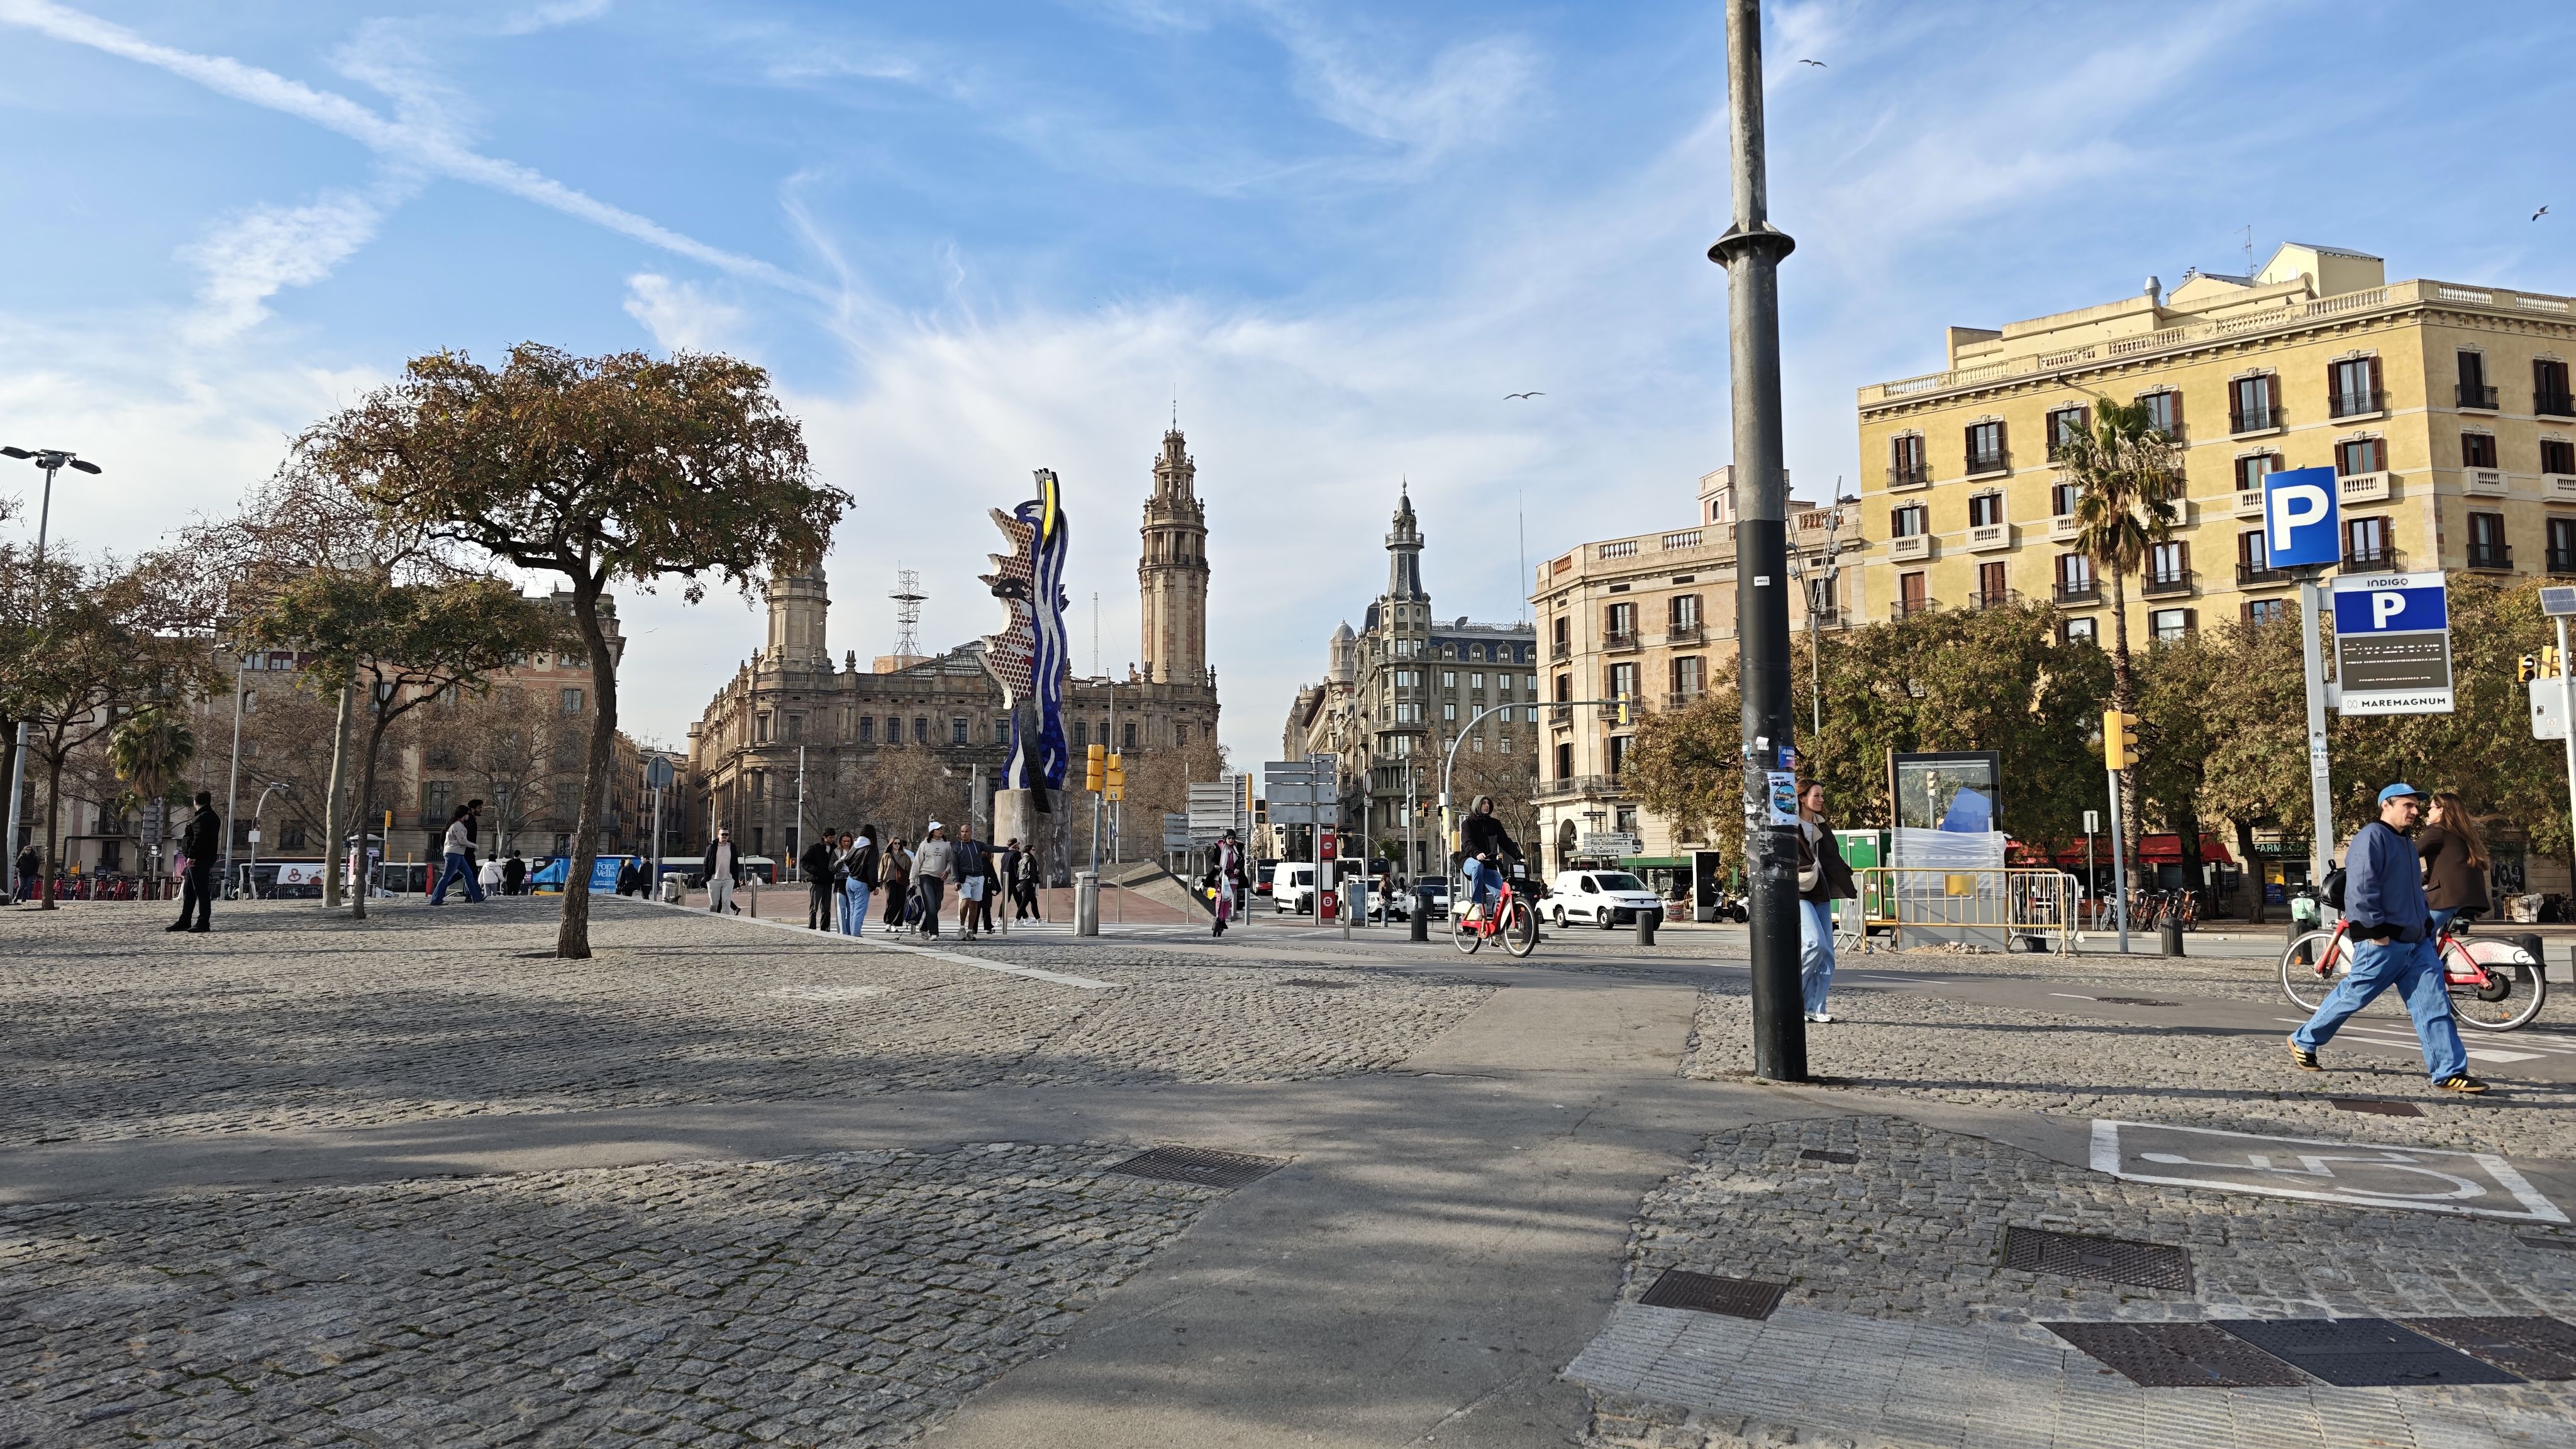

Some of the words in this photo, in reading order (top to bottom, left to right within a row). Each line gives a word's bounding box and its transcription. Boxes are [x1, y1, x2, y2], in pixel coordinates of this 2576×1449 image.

[2272, 484, 2329, 552] P
[2367, 577, 2409, 587] INDIGO
[2372, 592, 2406, 629] P
[2362, 696, 2446, 708] MAREMAGNUM
[597, 862, 615, 870] Font
